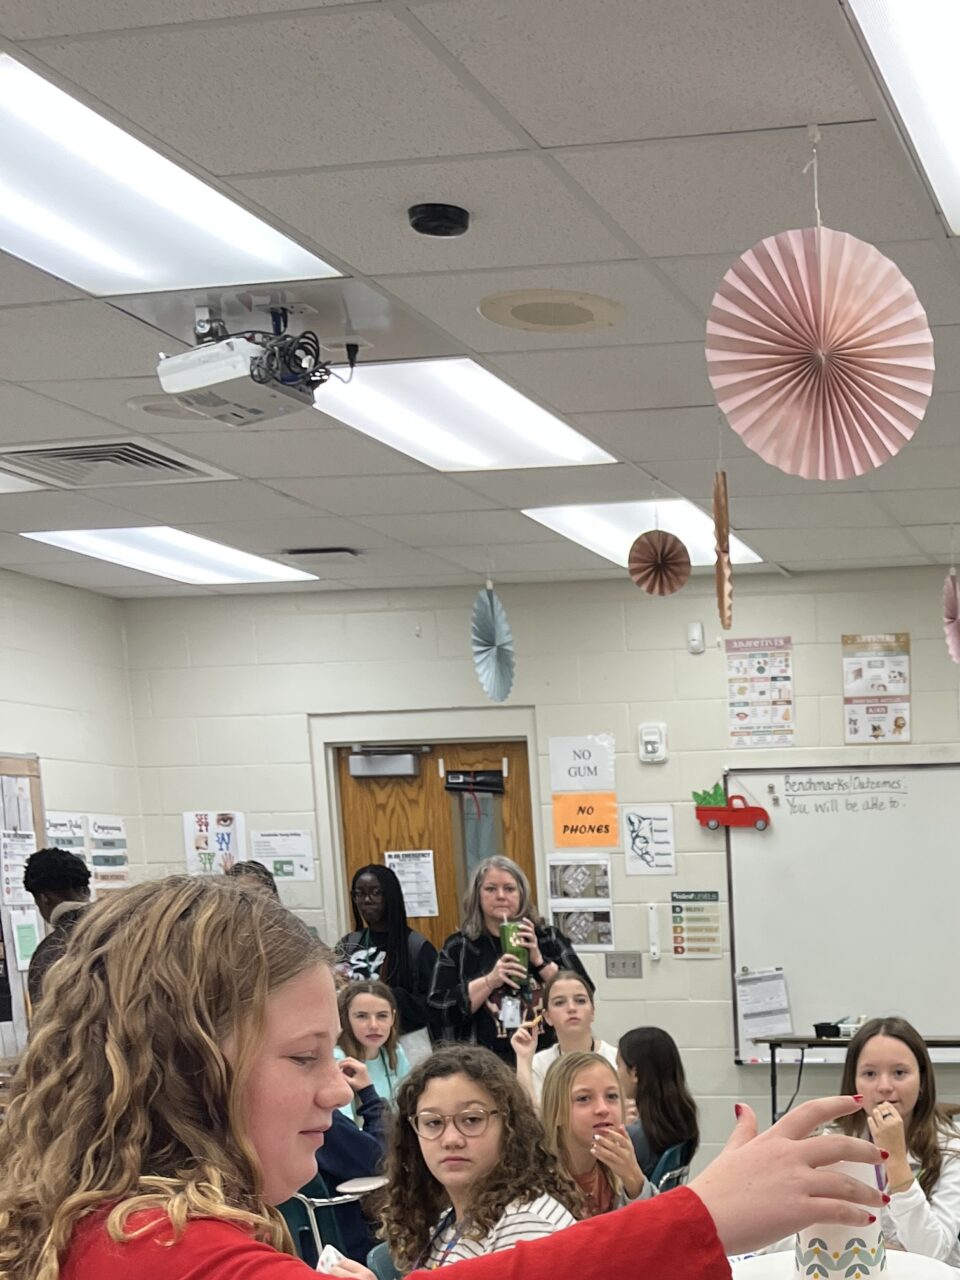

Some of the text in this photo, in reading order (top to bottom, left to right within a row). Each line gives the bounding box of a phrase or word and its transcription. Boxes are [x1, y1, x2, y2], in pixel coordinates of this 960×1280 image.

[732, 638, 785, 649] ADJECTIVES
[572, 749, 592, 761] NO
[567, 766, 598, 778] GUM
[577, 805, 594, 816] NO
[786, 797, 809, 814] You
[814, 799, 838, 813] will
[845, 798, 859, 812] be
[862, 797, 886, 811] able
[562, 824, 610, 834] PHONES
